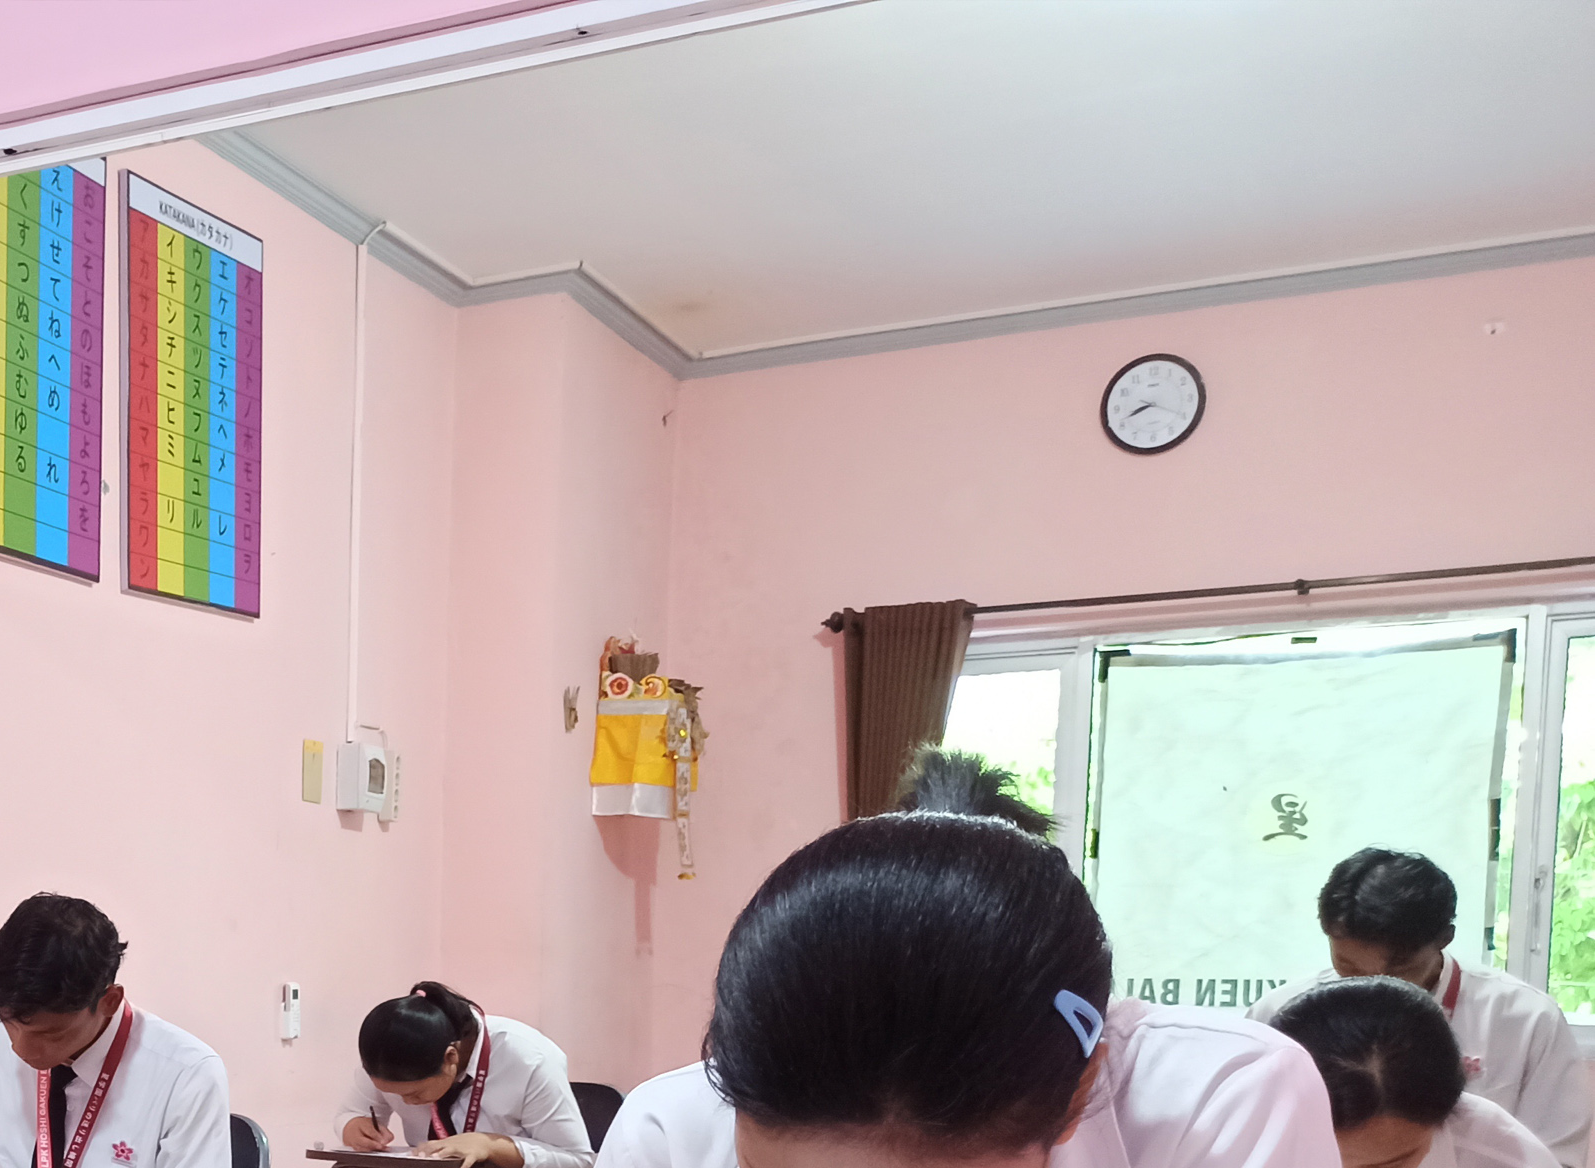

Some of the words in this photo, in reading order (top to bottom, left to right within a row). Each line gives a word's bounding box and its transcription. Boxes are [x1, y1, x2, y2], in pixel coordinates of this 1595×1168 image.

[51, 169, 62, 192] え
[19, 182, 28, 210] く
[51, 200, 63, 228] け
[84, 219, 93, 244] こ
[17, 219, 30, 248] す
[49, 238, 62, 265] せ
[83, 255, 93, 282] そ
[141, 219, 149, 243] ア
[166, 234, 175, 258] イ
[192, 244, 203, 271] ウ
[219, 260, 228, 281] エ
[17, 262, 30, 283] つ
[49, 277, 61, 301] て
[82, 291, 91, 318] と
[139, 252, 149, 280] カ
[166, 266, 177, 293] キ
[192, 279, 202, 303] ク
[219, 291, 228, 315] ケ
[245, 307, 253, 325] コ
[16, 295, 30, 323] ぬ
[48, 310, 61, 339] ね
[81, 329, 92, 352] の
[139, 289, 150, 313] サ
[166, 300, 176, 325] シ
[192, 313, 202, 337] ス
[218, 323, 228, 348] セ
[15, 333, 29, 361] ふ
[48, 354, 61, 372] へ
[80, 361, 92, 389] ほ
[140, 325, 148, 347] タ
[166, 336, 176, 358] チ
[192, 346, 202, 369] ツ
[218, 357, 228, 380] テ
[245, 366, 253, 390] ト
[15, 369, 29, 399] む
[48, 385, 60, 411] め
[81, 398, 91, 426] も
[139, 357, 149, 381] ナ
[166, 369, 176, 389] ニ
[192, 378, 201, 400] ヌ
[218, 386, 228, 412] ネ
[244, 405, 251, 418] ノ
[15, 407, 27, 435] ゆ
[80, 435, 90, 459] よ
[139, 395, 151, 413] ハ
[167, 401, 176, 425] ヒ
[192, 411, 202, 432] フ
[218, 423, 228, 440] ヘ
[15, 445, 27, 473] る
[46, 456, 60, 484] れ
[80, 470, 90, 496] ろ
[139, 426, 149, 447] マ
[168, 434, 175, 457] ミ
[192, 442, 202, 466] ム
[218, 451, 226, 472] メ
[244, 462, 253, 482] モ
[139, 457, 149, 482] ヤ
[192, 477, 202, 497] ユ
[244, 492, 252, 513] ヨ
[79, 507, 89, 532] を
[139, 524, 149, 547] ワ
[140, 492, 149, 515] ラ
[167, 498, 175, 523] リ
[192, 507, 202, 530] ル
[219, 515, 228, 536] レ
[244, 524, 252, 542] ロ
[139, 558, 150, 579] ン
[39, 1076, 48, 1116] GAKUEN
[39, 1117, 48, 1148] HOSHI
[41, 1149, 49, 1168] LPK
